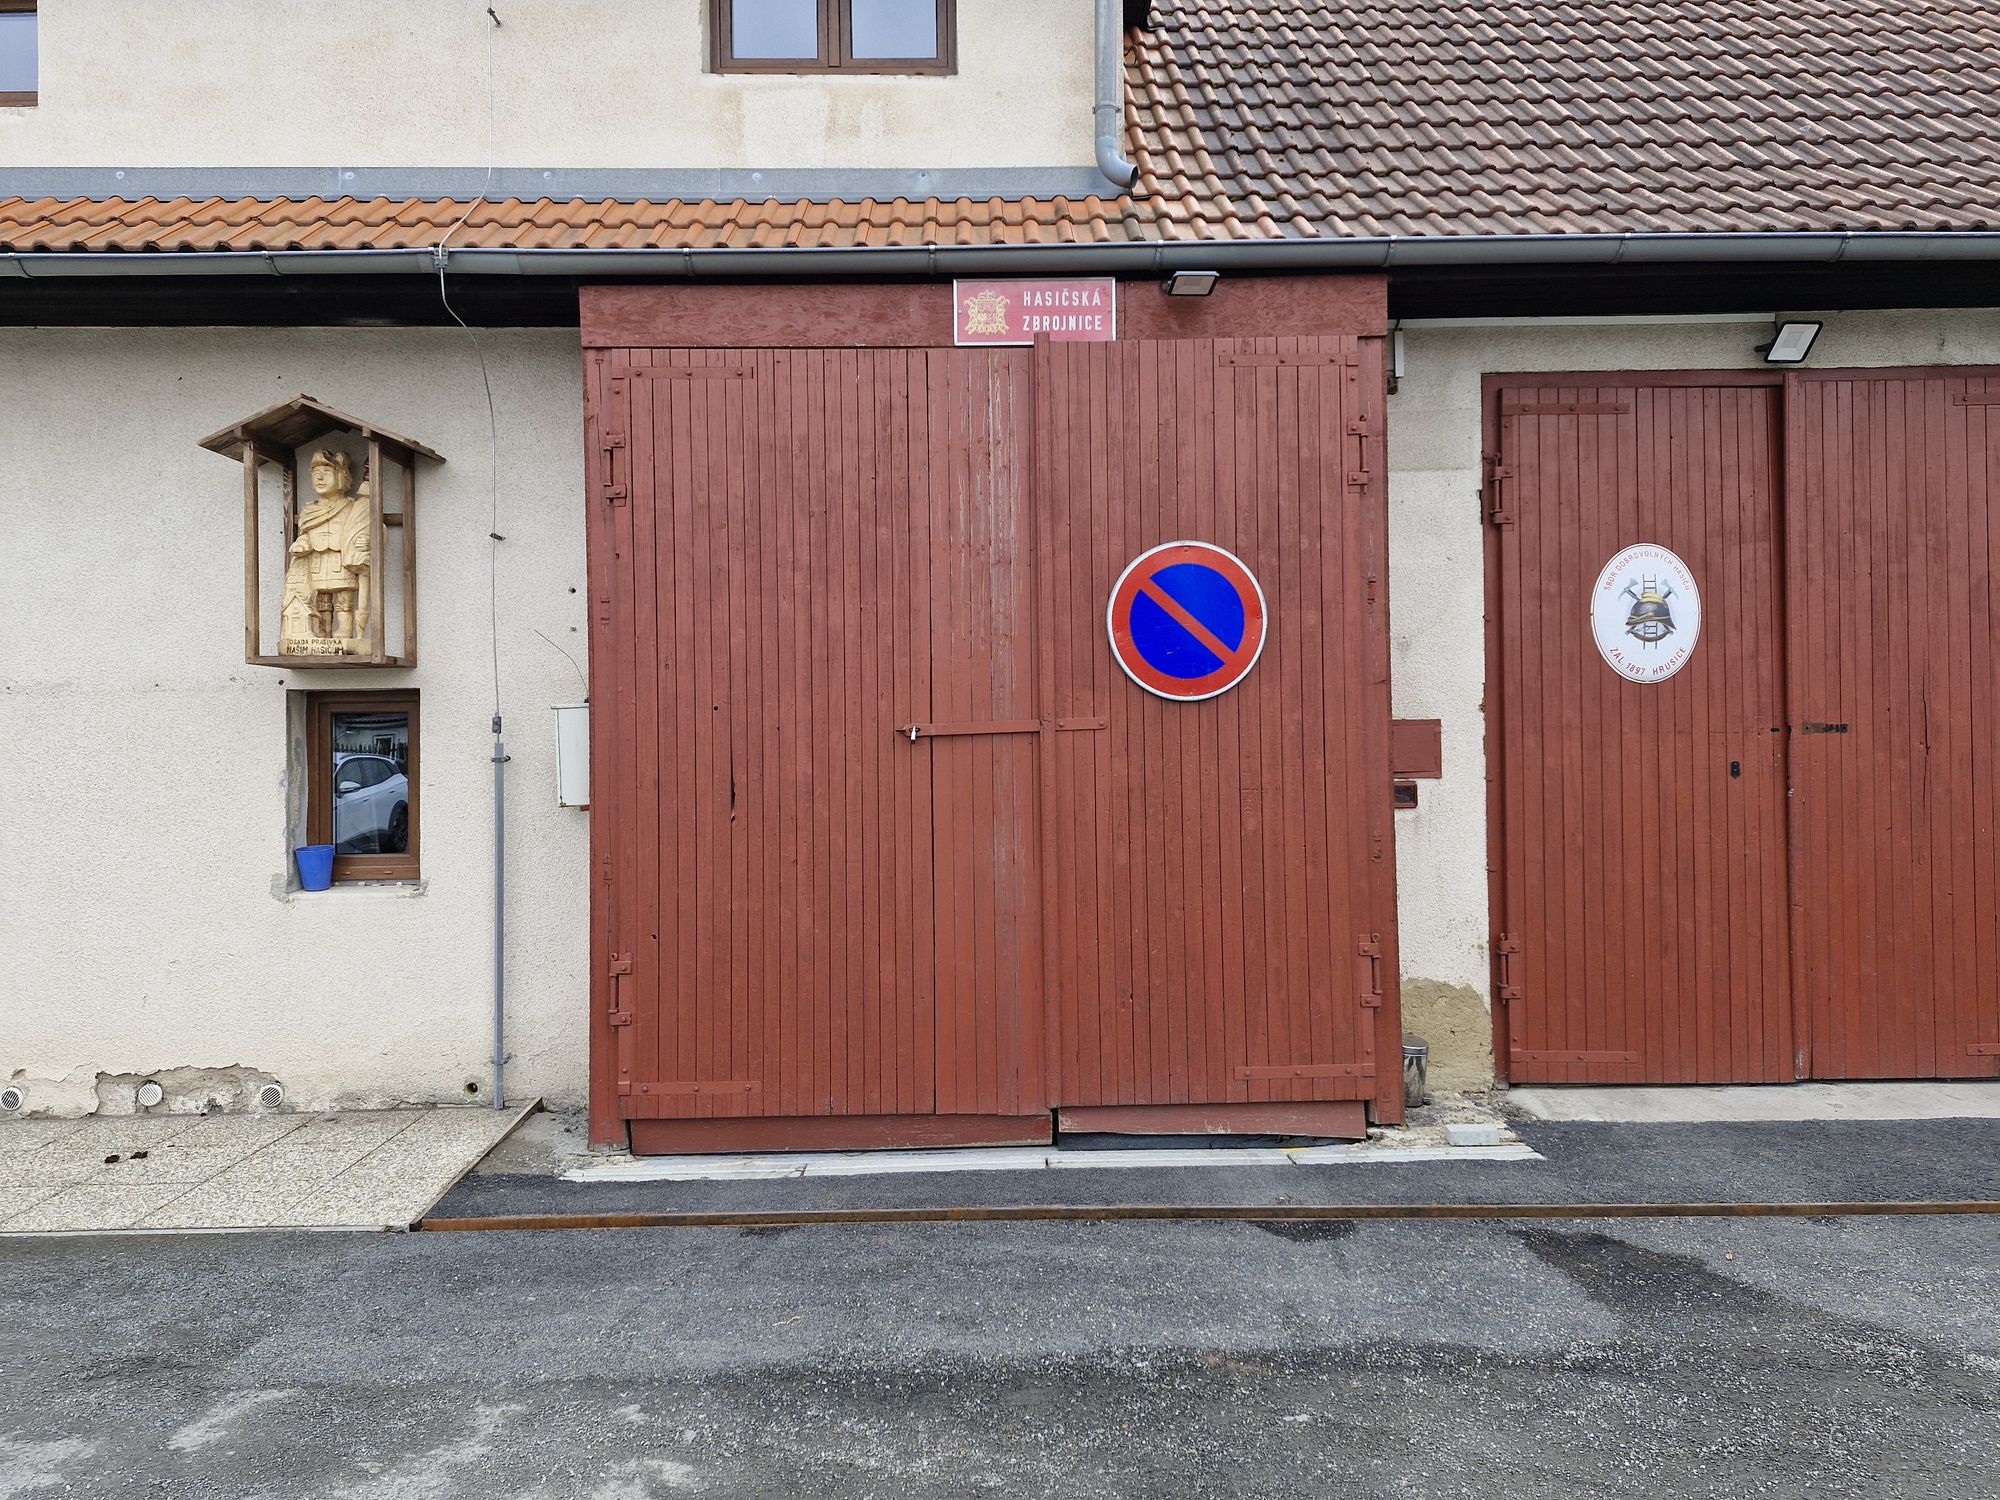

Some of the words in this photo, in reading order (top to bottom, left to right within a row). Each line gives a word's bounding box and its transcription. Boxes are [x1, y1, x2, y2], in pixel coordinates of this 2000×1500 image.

[1023, 288, 1102, 307] HASIČSKÁ
[1022, 315, 1103, 331] ZBROJNICE
[1625, 662, 1646, 676] 1897
[1652, 646, 1687, 676] HRUSICE
